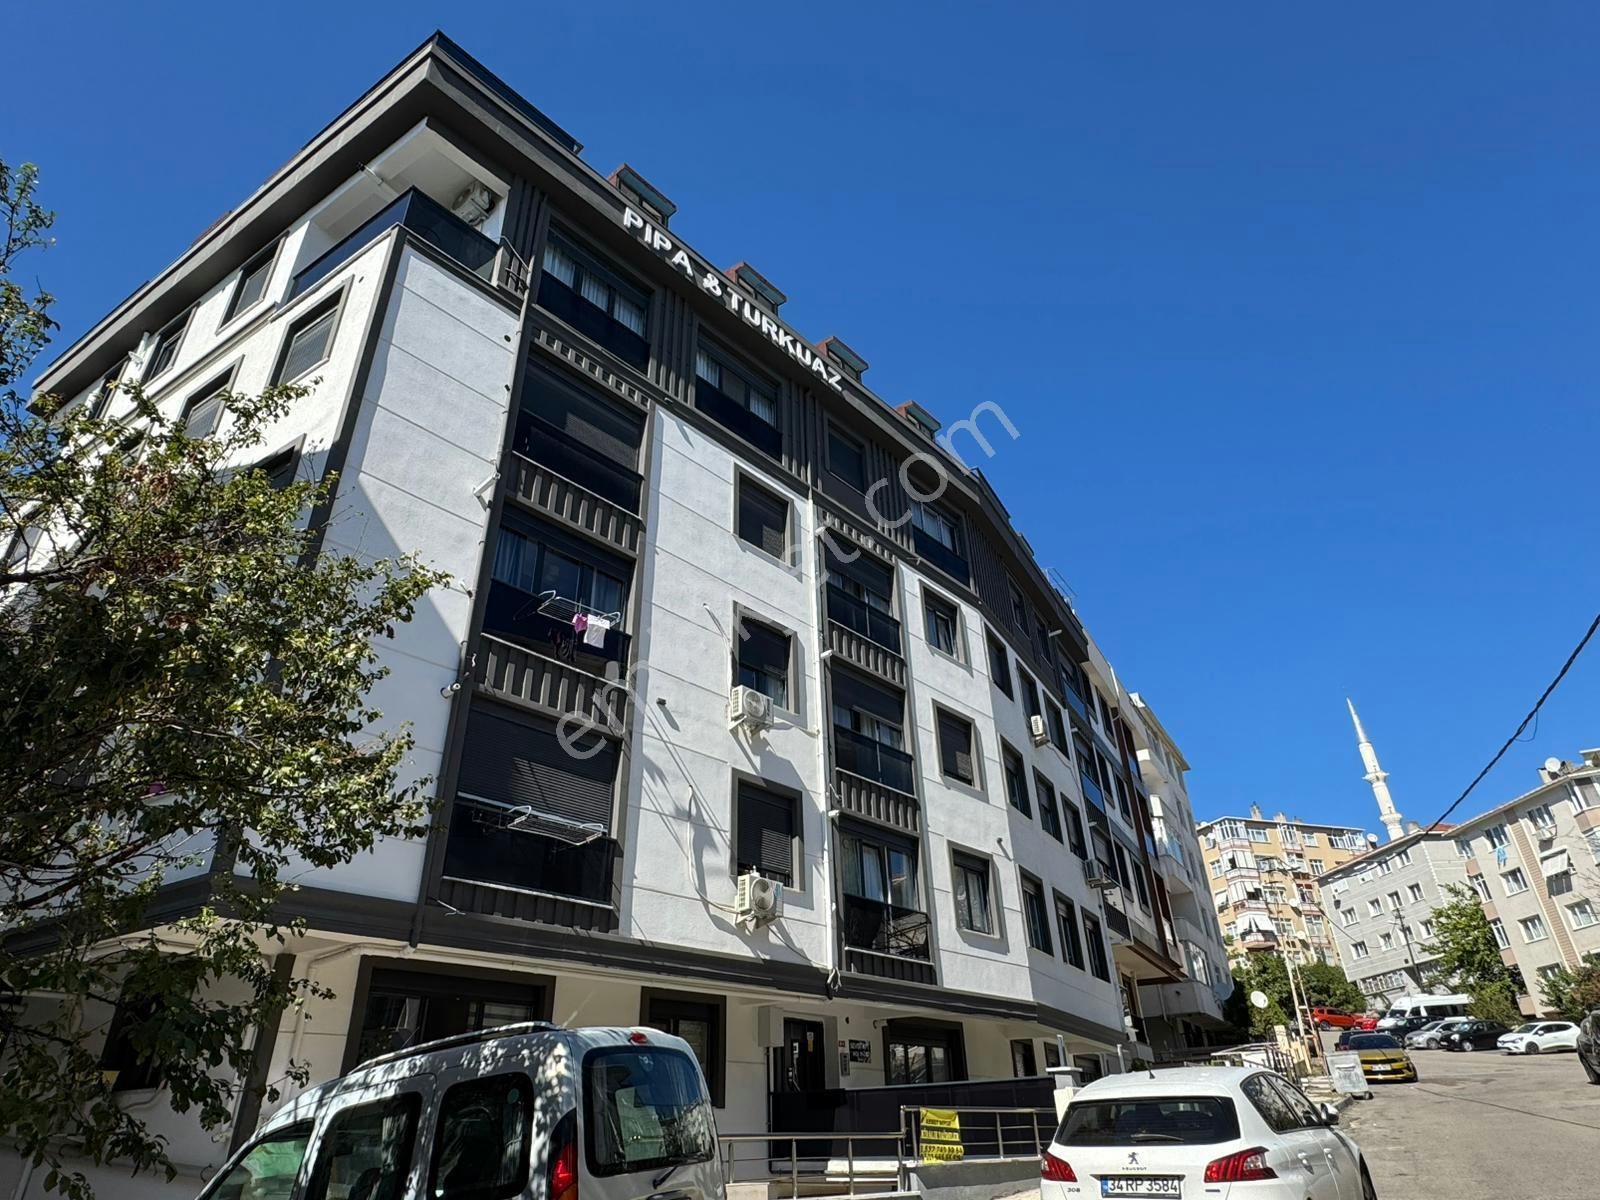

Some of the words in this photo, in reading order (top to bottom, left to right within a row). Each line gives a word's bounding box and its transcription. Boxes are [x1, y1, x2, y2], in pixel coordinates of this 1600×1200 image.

[623, 206, 694, 277] PIPA
[702, 272, 722, 297] &
[726, 286, 843, 391] TURKUAZ
[1109, 1177, 1124, 1192] 34
[1125, 1177, 1144, 1192] RP
[1146, 1177, 1178, 1193] 3584
